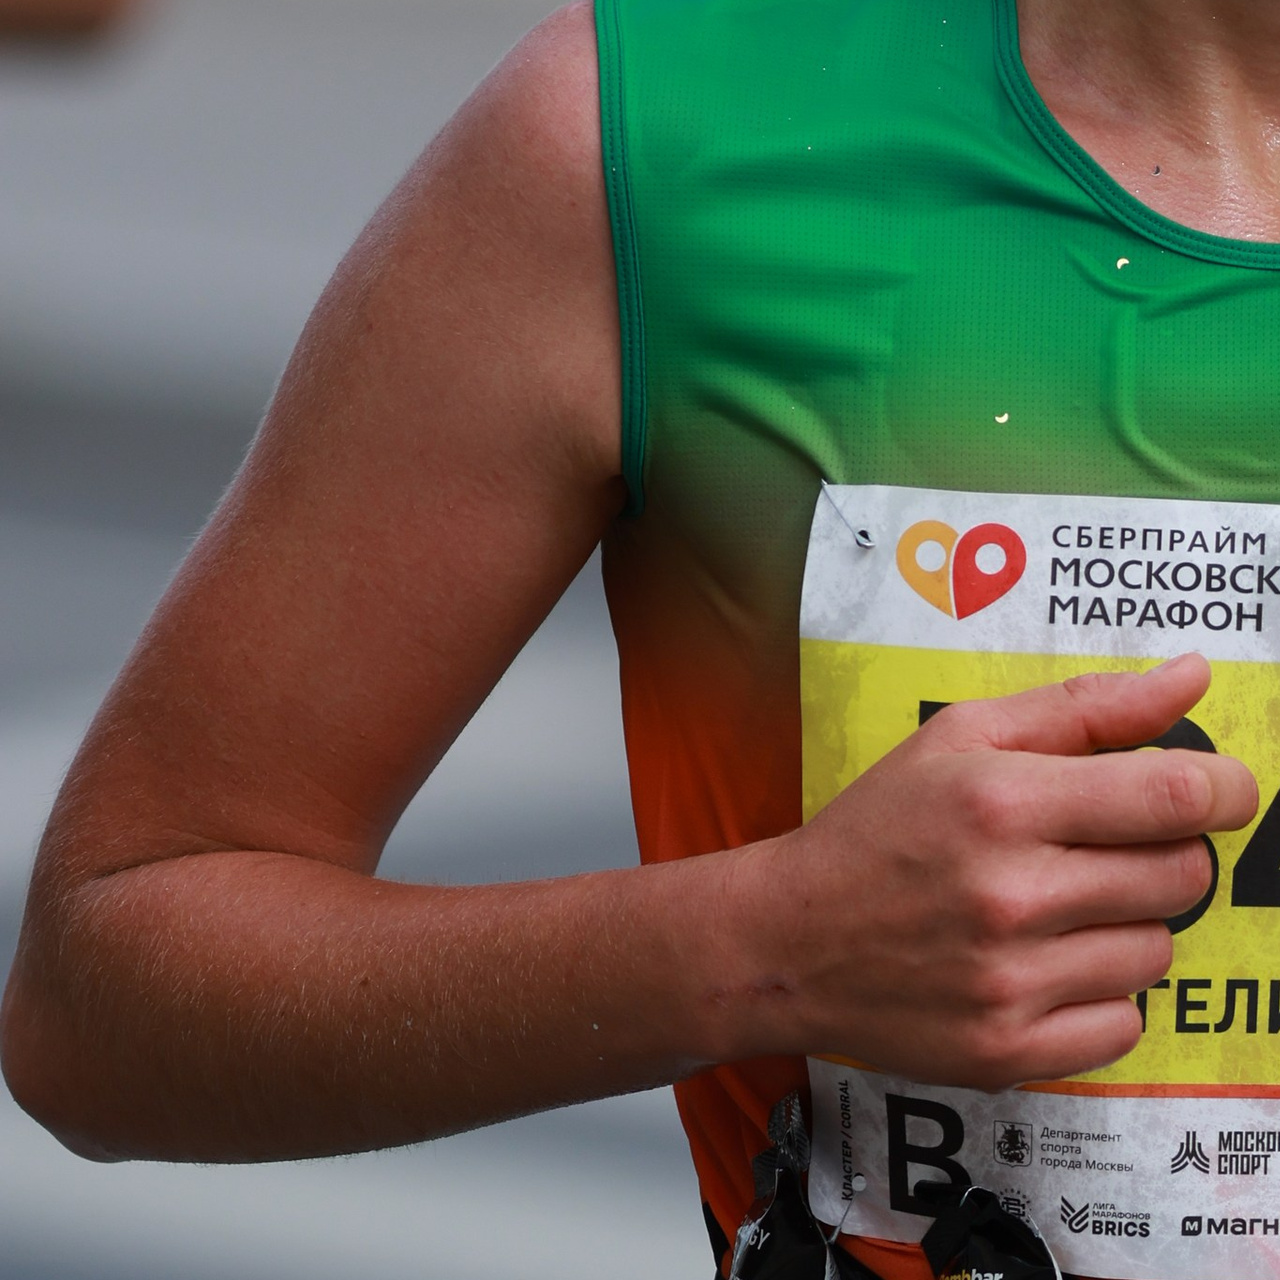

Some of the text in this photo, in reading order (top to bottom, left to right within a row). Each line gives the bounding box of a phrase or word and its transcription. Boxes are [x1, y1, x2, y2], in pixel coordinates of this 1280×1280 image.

[1052, 525, 1267, 556] СБЕРПРАЙМ
[1049, 594, 1264, 633] МАРАФОН
[838, 1079, 853, 1129] CORRAL
[1040, 1127, 1122, 1143] Департамент
[1040, 1143, 1082, 1156] спорта
[841, 1140, 854, 1202] КЛАСТЕР
[1040, 1156, 1134, 1172] города Москвы
[1218, 1154, 1271, 1175] СПОРТ
[1092, 1202, 1116, 1210] ЛИГА
[1092, 1210, 1151, 1220] МАРАФОНОВ
[1092, 1220, 1150, 1238] BRICS
